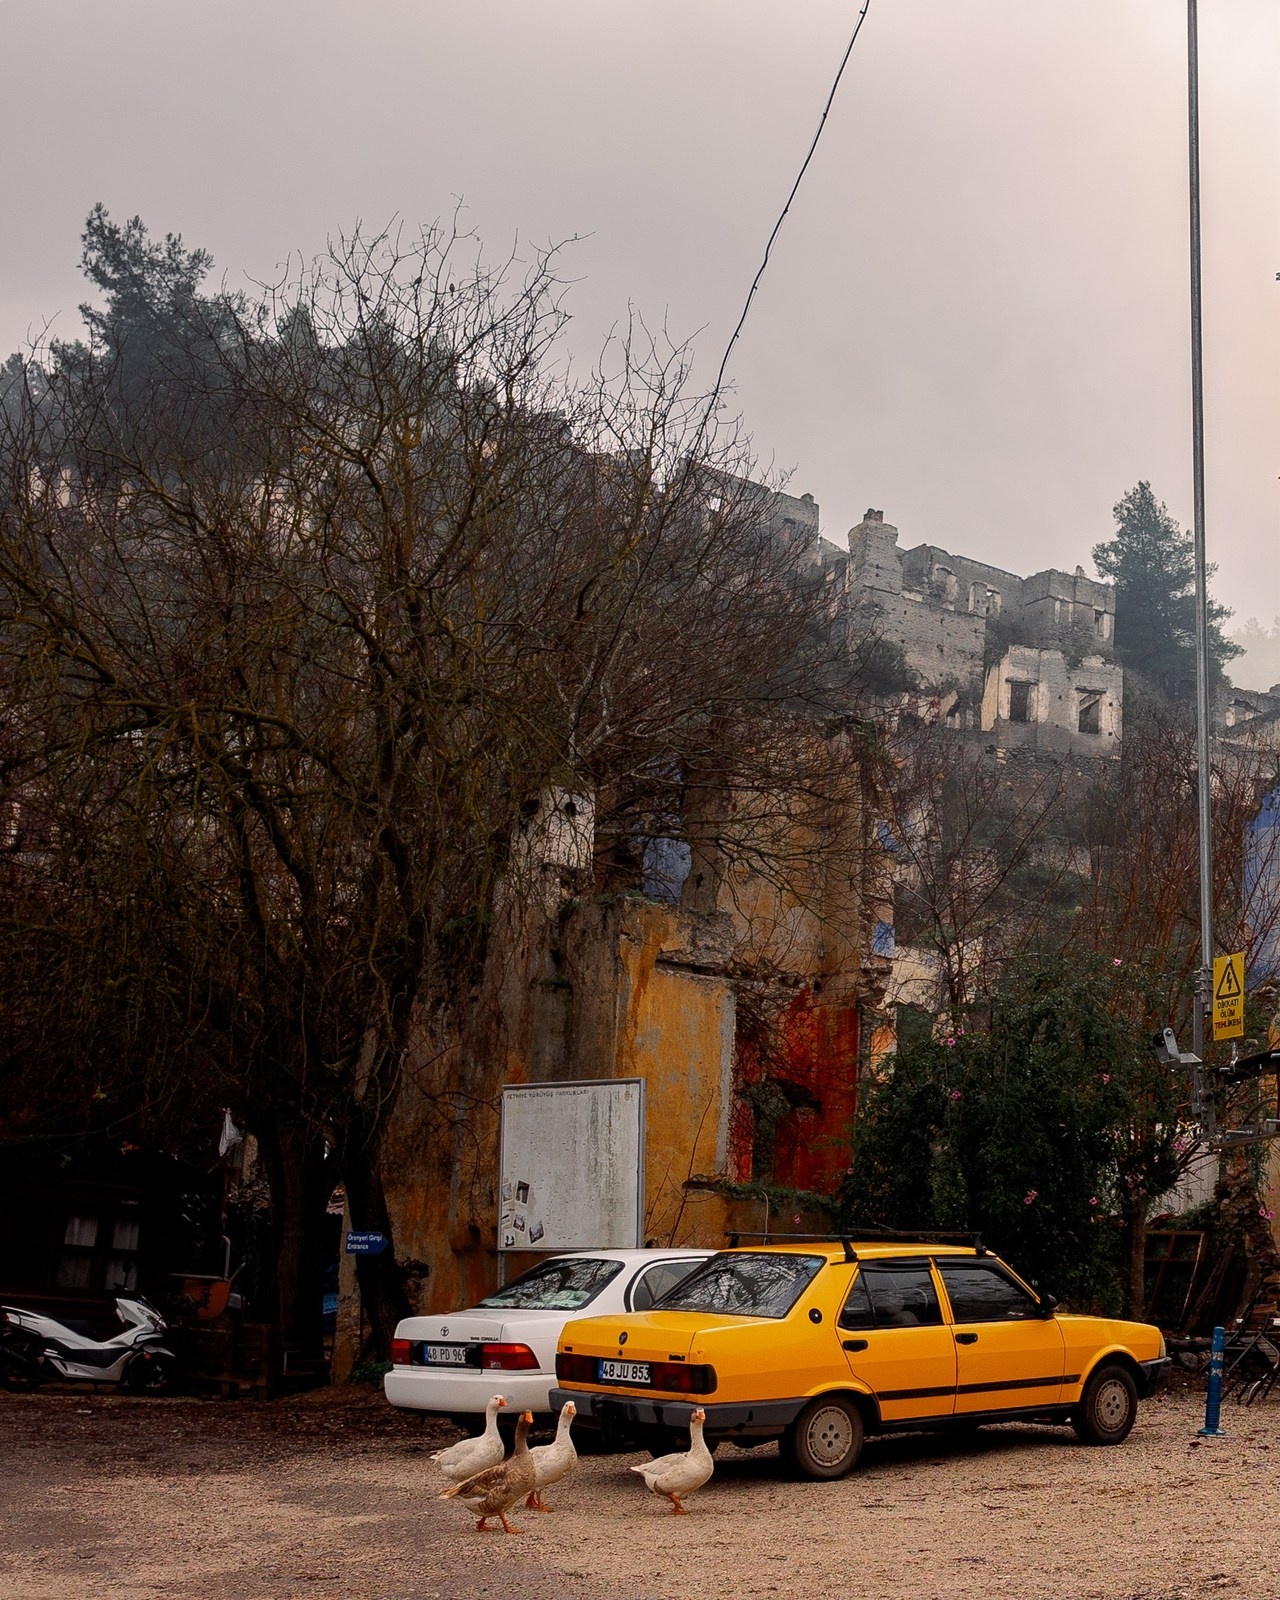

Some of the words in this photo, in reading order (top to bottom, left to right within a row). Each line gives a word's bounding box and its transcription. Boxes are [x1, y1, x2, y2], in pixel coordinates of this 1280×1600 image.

[440, 1348, 450, 1361] PD
[603, 1363, 615, 1377] 48
[616, 1365, 629, 1379] JU
[631, 1366, 650, 1381] 853
